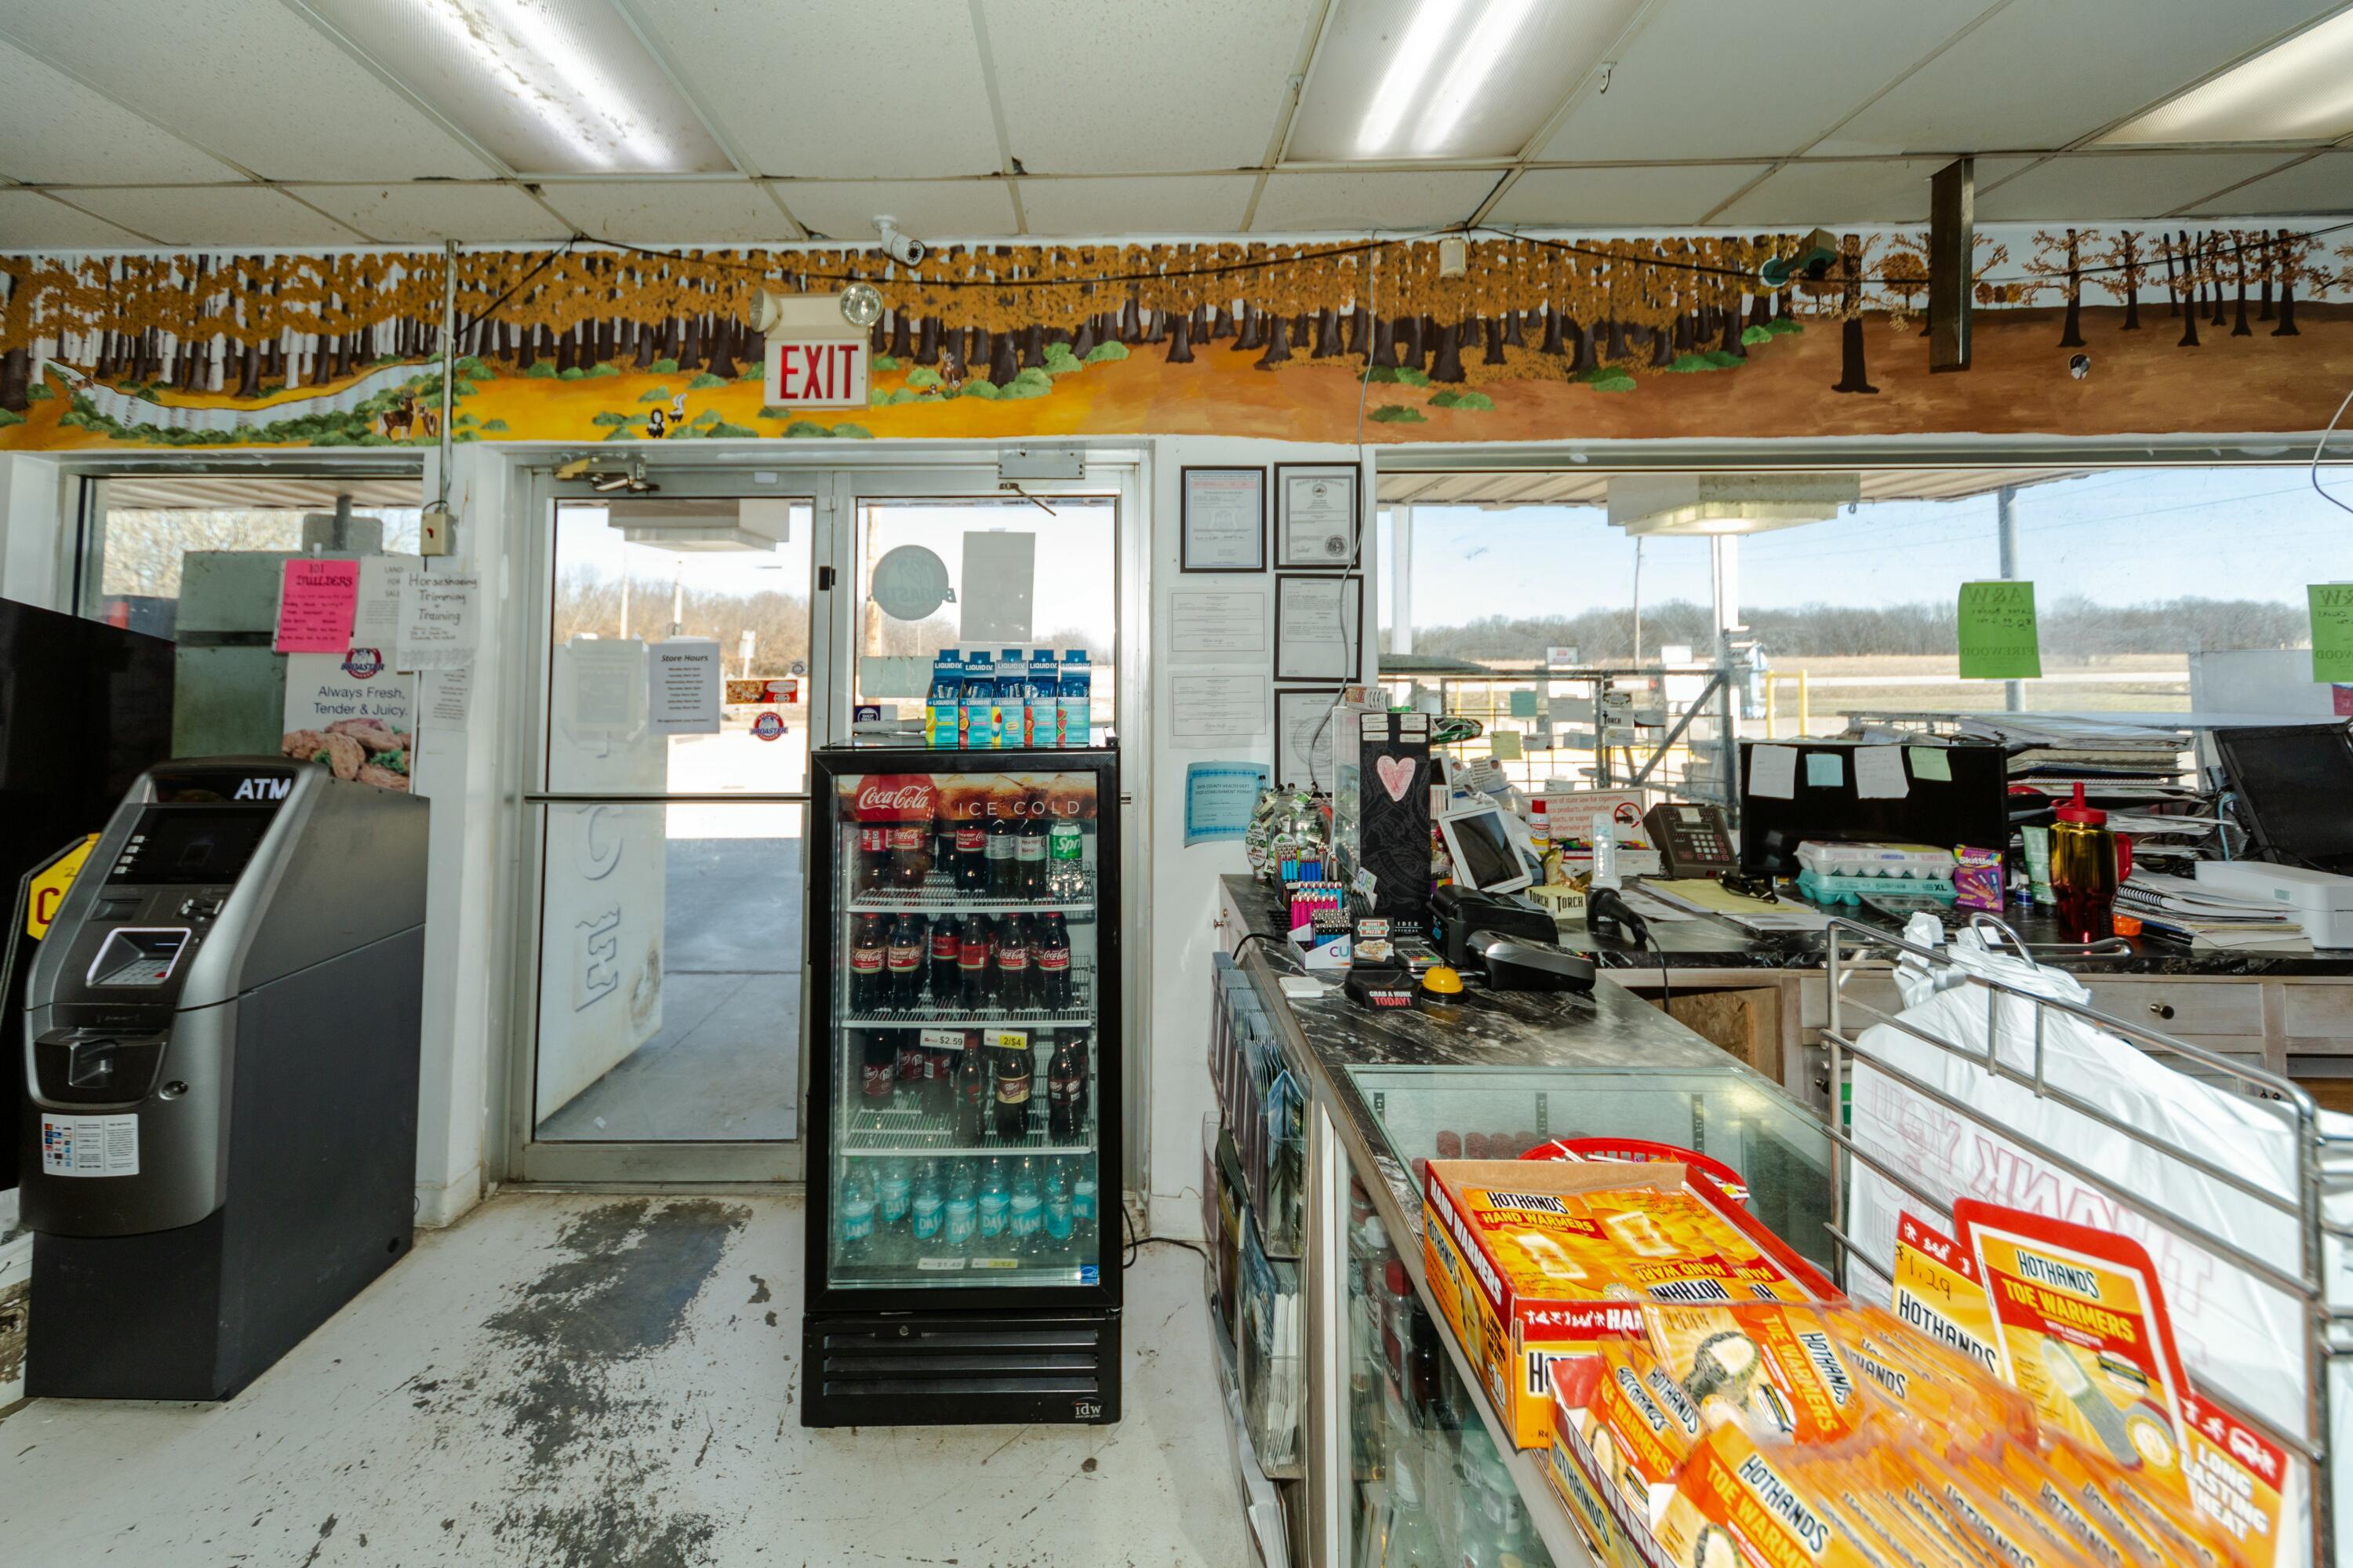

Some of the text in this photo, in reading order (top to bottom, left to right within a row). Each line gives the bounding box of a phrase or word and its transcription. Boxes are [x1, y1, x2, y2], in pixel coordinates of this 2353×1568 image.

[780, 345, 859, 399] EXIT
[419, 589, 467, 604] Trimming
[419, 608, 461, 626] Training
[318, 686, 406, 700] Always Fresh,
[313, 702, 409, 719] Tender & Juicy.
[1602, 710, 1622, 726] TORCH
[234, 777, 293, 800] ATM
[859, 785, 933, 810] Coca-Cola
[958, 800, 1081, 816] ICE COLD
[1056, 836, 1081, 853] Spri
[1958, 855, 1999, 867] Skittles
[1933, 883, 1956, 892] XL
[1528, 889, 1550, 908] TORCH
[1556, 895, 1584, 913] TORCH
[855, 950, 882, 962] Coca-Cola
[999, 948, 1027, 960] Coca-Cola
[1329, 945, 1351, 958] CU
[1373, 996, 1412, 1007] TODAY!
[939, 1035, 963, 1046] $2.59
[1003, 1036, 1022, 1046] 2/$4
[1487, 1191, 1569, 1215] HOTHANDS
[918, 1216, 940, 1231] DAS
[1481, 1211, 1595, 1232] HAND WARMERS
[1427, 1210, 1457, 1286] HOTHANDS
[1431, 1175, 1453, 1227] HAND
[1454, 1211, 1503, 1307] WARMERS
[1680, 1261, 1727, 1277] HAND
[1733, 1266, 1776, 1281] HAN
[2016, 1249, 2100, 1299] HOTHANDS
[1648, 1278, 1732, 1301] HOTHAN
[1606, 1308, 1646, 1331] HAN
[2001, 1278, 2137, 1344] TOE WARMERS
[1487, 1310, 1502, 1341] LONG
[1483, 1317, 1507, 1362] LASTING
[1761, 1313, 1791, 1344] TOE
[1777, 1341, 1839, 1433] WARMERS
[1798, 1331, 1855, 1406] HOTHANDS
[1075, 1402, 1102, 1415] idw
[1614, 1401, 1673, 1480] WARMERS
[2196, 1442, 2254, 1501] LONG
[1706, 1458, 1743, 1507] TOE
[1738, 1453, 1830, 1554] HOTHANDS
[2179, 1450, 2269, 1538] LASTING
[2196, 1493, 2249, 1544] HEAT
